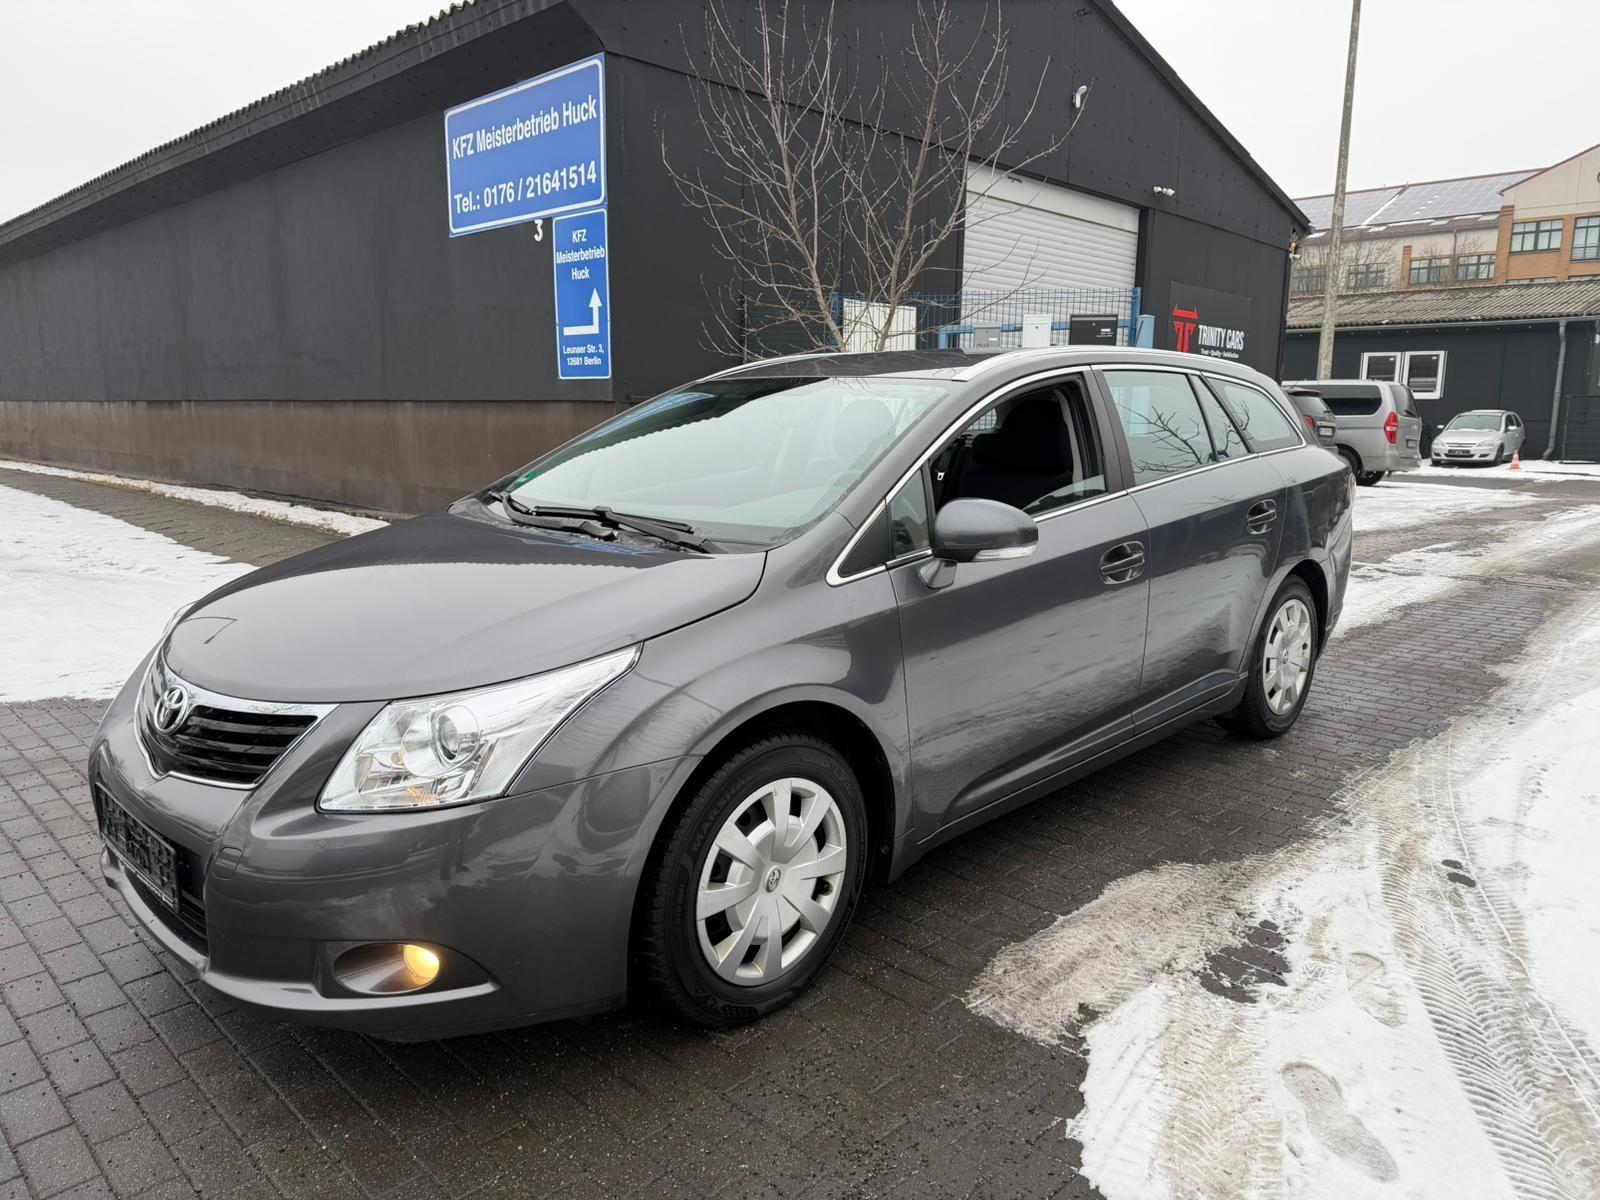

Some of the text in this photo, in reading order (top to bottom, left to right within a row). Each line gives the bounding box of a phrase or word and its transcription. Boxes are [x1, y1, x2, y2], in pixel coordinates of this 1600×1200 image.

[452, 94, 598, 160] KFZ Meisterbetrieb Huck
[454, 160, 597, 214] Tel.: 0176 / 21641514
[533, 219, 544, 242] 3
[572, 229, 587, 243] KFZ
[556, 245, 605, 264] Meisterbetrieb
[571, 267, 590, 281] Huck
[1198, 324, 1244, 350] TRINITY CARS
[586, 344, 597, 354] Str.
[583, 355, 602, 366] Berlin
